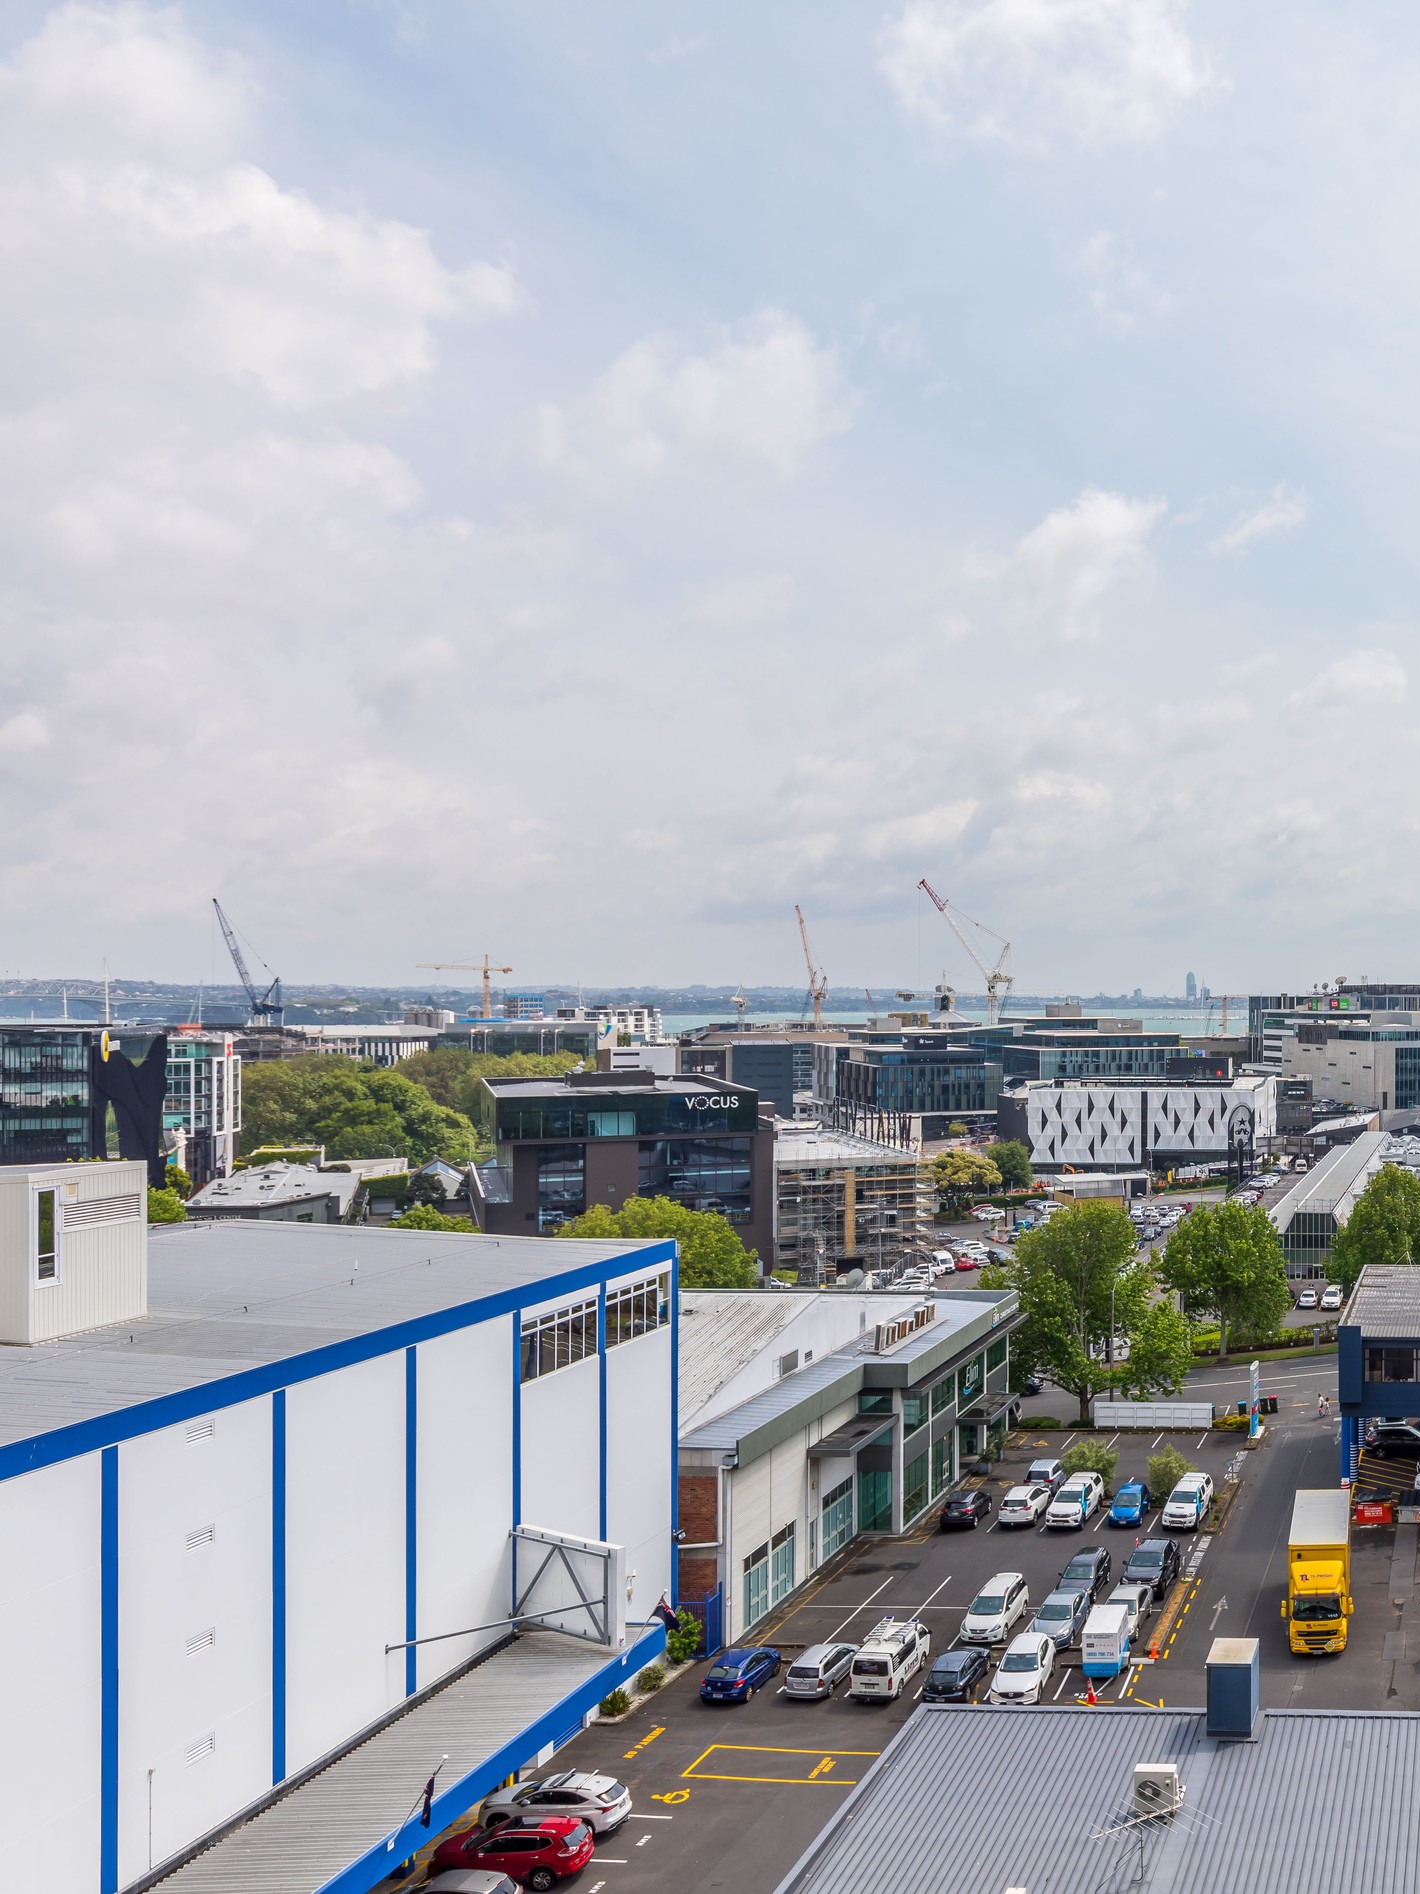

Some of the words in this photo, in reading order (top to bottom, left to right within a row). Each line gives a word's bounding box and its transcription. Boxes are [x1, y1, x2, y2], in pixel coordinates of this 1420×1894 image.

[685, 1096, 739, 1109] VOCUS
[1196, 1536, 1212, 1551] PARKING
[1189, 1552, 1205, 1567] VISITOR
[623, 1750, 638, 1758] NO
[634, 1727, 666, 1748] PARKING
[808, 1756, 832, 1778] CONTAINER
[822, 1761, 836, 1772] HERE
